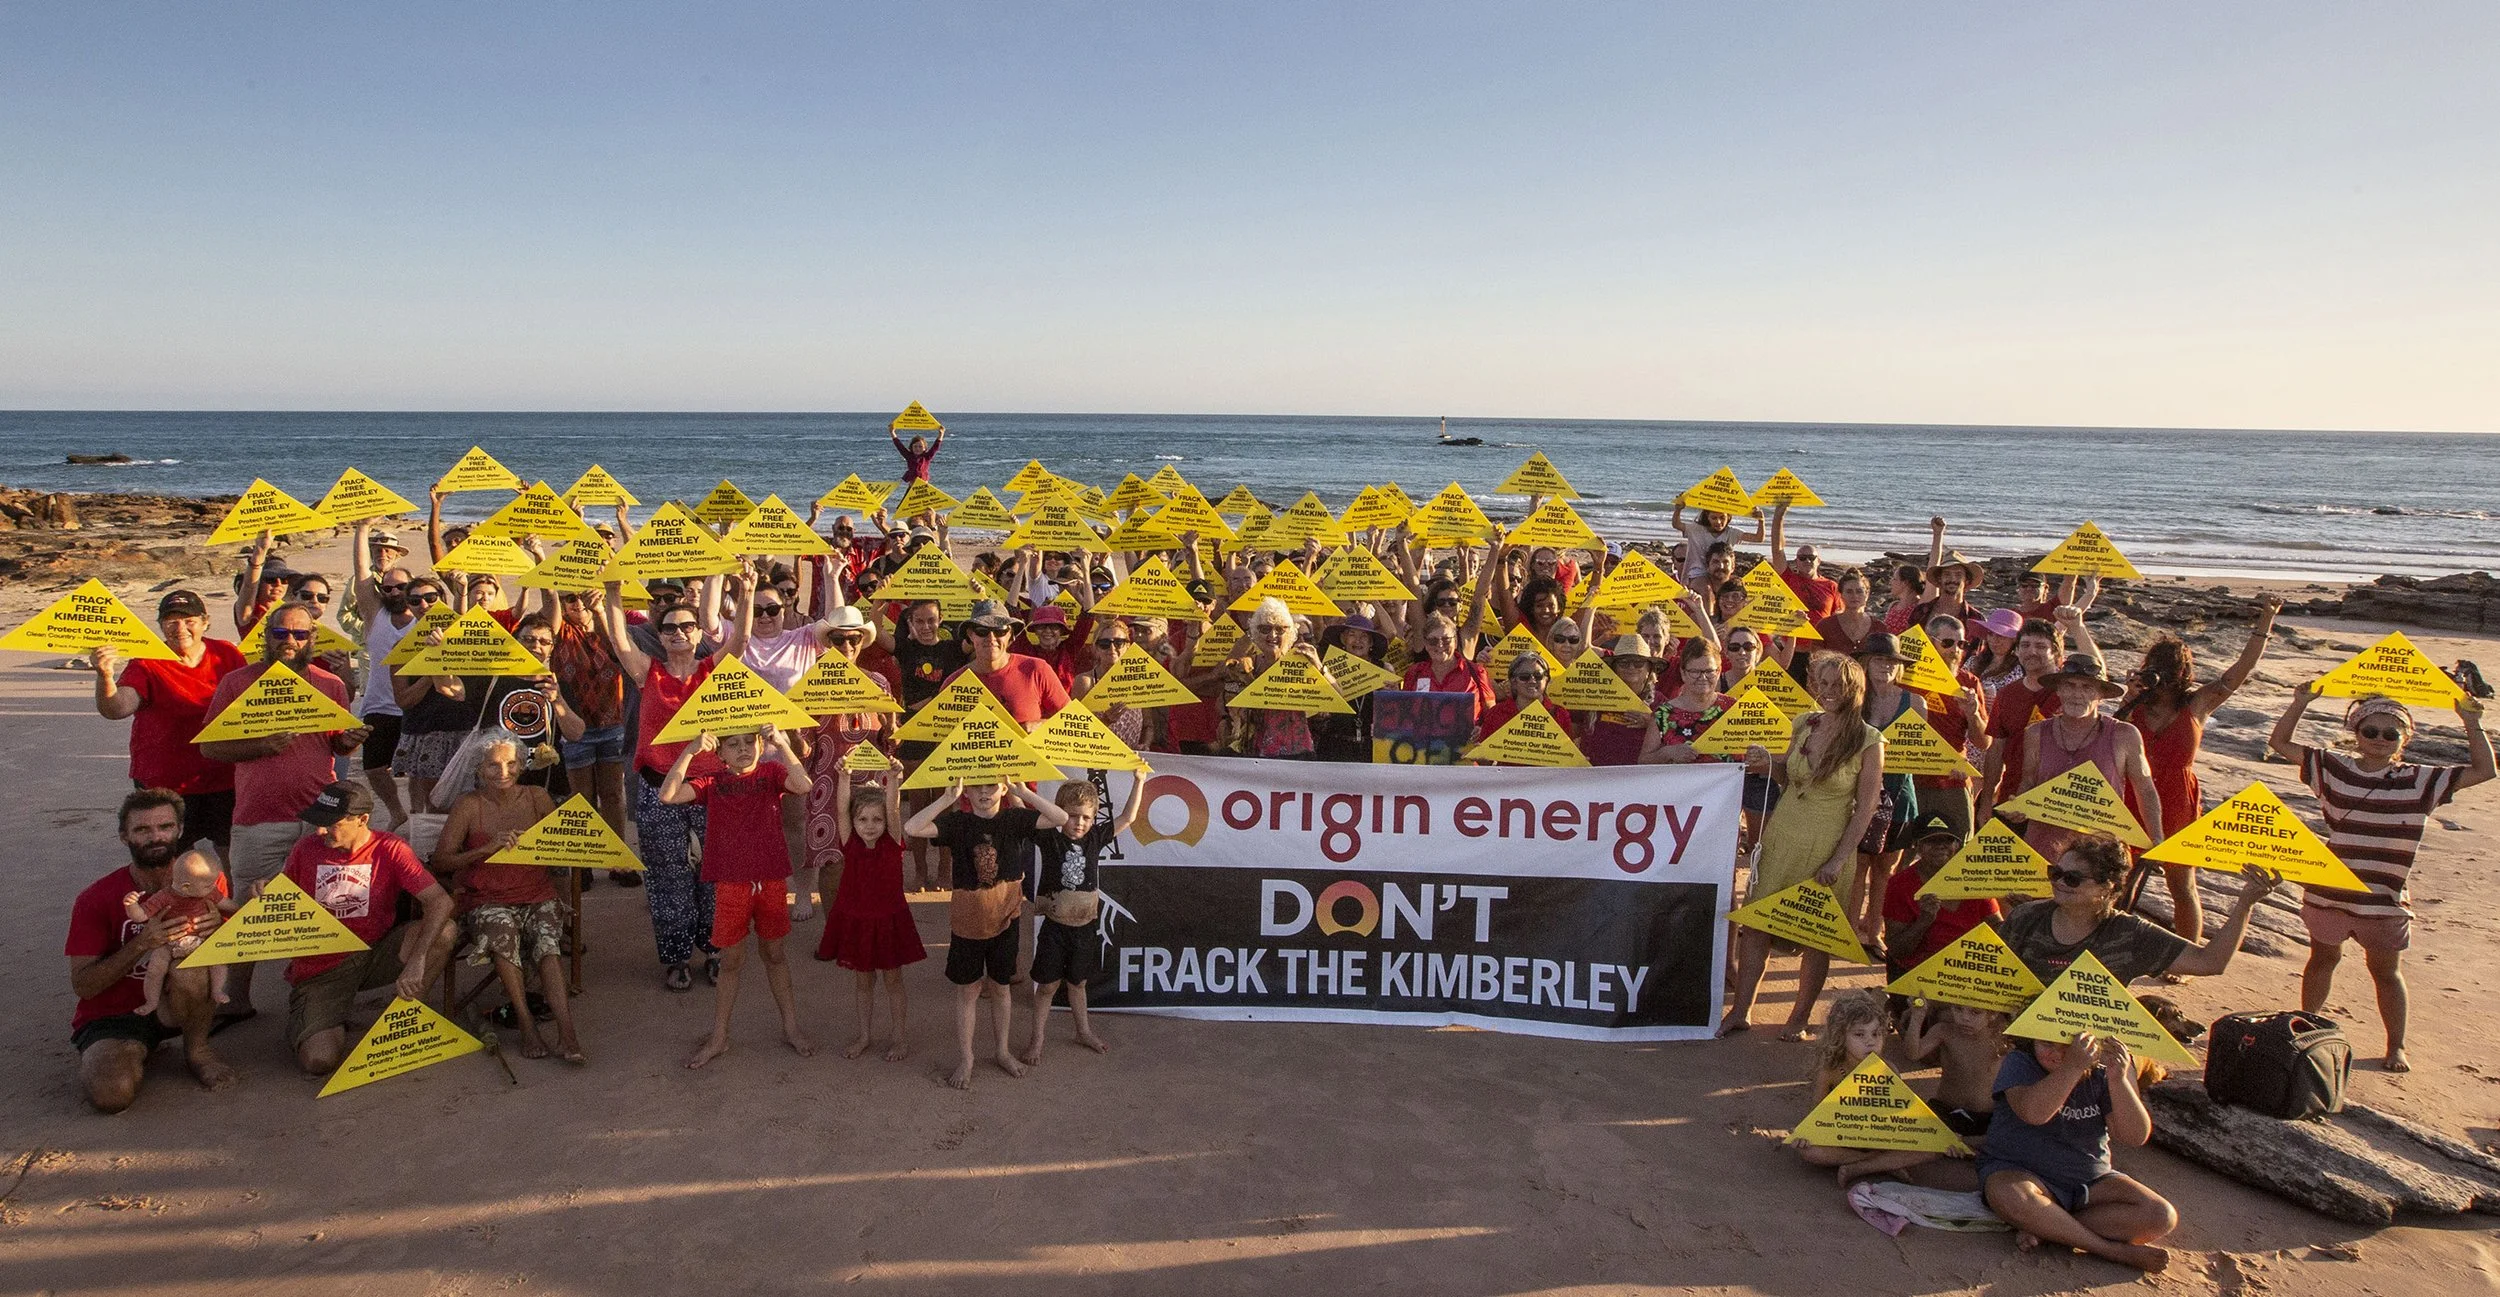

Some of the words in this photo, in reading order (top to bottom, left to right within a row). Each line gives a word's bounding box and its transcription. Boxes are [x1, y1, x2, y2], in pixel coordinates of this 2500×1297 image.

[1521, 470, 1555, 478] KIMBERLEY
[1431, 505, 1472, 513] KIMBERLEY
[650, 518, 686, 527] FRACK
[1534, 517, 1576, 525] KIMBERLEY
[655, 527, 682, 536] FREE
[639, 535, 699, 546] KIMBERLEY
[1147, 569, 1161, 577] NO
[1129, 577, 1177, 588] FRACKING
[71, 594, 113, 605] FRACK
[75, 604, 107, 614] FREE
[54, 612, 126, 624] KIMBERLEY
[459, 620, 493, 628] FRACK
[46, 624, 81, 633] Protect
[446, 637, 505, 645] KIMBERLEY
[2374, 646, 2415, 656] FRACK
[2378, 655, 2409, 664] FREE
[2357, 661, 2428, 675] KIMBERLEY
[259, 677, 298, 687] FRACK
[712, 670, 749, 682] FRACK
[2350, 673, 2383, 682] Protect
[2385, 676, 2402, 684] Our
[2405, 678, 2432, 686] Water
[264, 686, 294, 696] FREE
[717, 680, 745, 691] FREE
[245, 694, 312, 706] KIMBERLEY
[701, 688, 764, 703] KIMBERLEY
[240, 710, 273, 718] Protect
[697, 707, 727, 716] Protect
[729, 705, 744, 713] Our
[746, 703, 771, 711] Water
[300, 712, 337, 720] Community
[962, 720, 999, 730] FRACK
[967, 730, 995, 740] FREE
[950, 739, 1013, 751] KIMBERLEY
[946, 756, 976, 764] Protect
[2067, 772, 2104, 787] FRACK
[2069, 781, 2098, 794] FREE
[2051, 786, 2113, 807] KIMBERLEY
[2043, 796, 2072, 809] Protect
[2074, 804, 2090, 813] Our
[2091, 808, 2116, 819] Water
[2231, 799, 2281, 815] FRACK
[2236, 812, 2274, 825] FREE
[1222, 790, 1430, 862] origin
[1454, 797, 1702, 873] energy
[2212, 820, 2298, 839] KIMBERLEY
[2204, 834, 2244, 847] Protect
[2246, 840, 2267, 850] Our
[2270, 844, 2304, 855] Water
[2181, 840, 2204, 849] Clean
[2205, 843, 2237, 855] Country
[2245, 850, 2277, 861] Healthy
[2278, 854, 2328, 868] Community
[259, 892, 300, 903] FRACK
[264, 902, 295, 912] FREE
[243, 911, 314, 924] KIMBERLEY
[236, 929, 271, 938] Protect
[237, 938, 266, 946] Country
[300, 932, 339, 940] Community
[1119, 947, 1268, 994] FRACK
[1278, 948, 1367, 996] THE
[1381, 951, 1649, 1014] KIMBERLEY
[2069, 969, 2112, 985] FRACK
[2076, 982, 2109, 996] FREE
[2058, 990, 2130, 1011] KIMBERLEY
[384, 1005, 421, 1022] FRACK
[2054, 1007, 2089, 1020] Protect
[2091, 1013, 2109, 1023] Our
[2111, 1016, 2139, 1028] Water
[389, 1016, 417, 1031] FREE
[2036, 1013, 2057, 1022] Clean
[2057, 1016, 2086, 1028] Country
[2092, 1022, 2119, 1034] Healthy
[2120, 1027, 2160, 1041] Community
[371, 1021, 435, 1046] KIMBERLEY
[366, 1046, 398, 1060] Protect
[399, 1042, 415, 1050] Our
[417, 1035, 441, 1045] Water
[1853, 1073, 1894, 1085] FRACK
[1858, 1085, 1890, 1096] FREE
[1839, 1095, 1910, 1109] KIMBERLEY
[1834, 1112, 1868, 1121] Protect
[1870, 1114, 1887, 1122] Our
[1889, 1115, 1917, 1124] Water
[1835, 1121, 1863, 1130] Country
[1870, 1123, 1896, 1132] Healthy
[1897, 1124, 1937, 1134] Community
